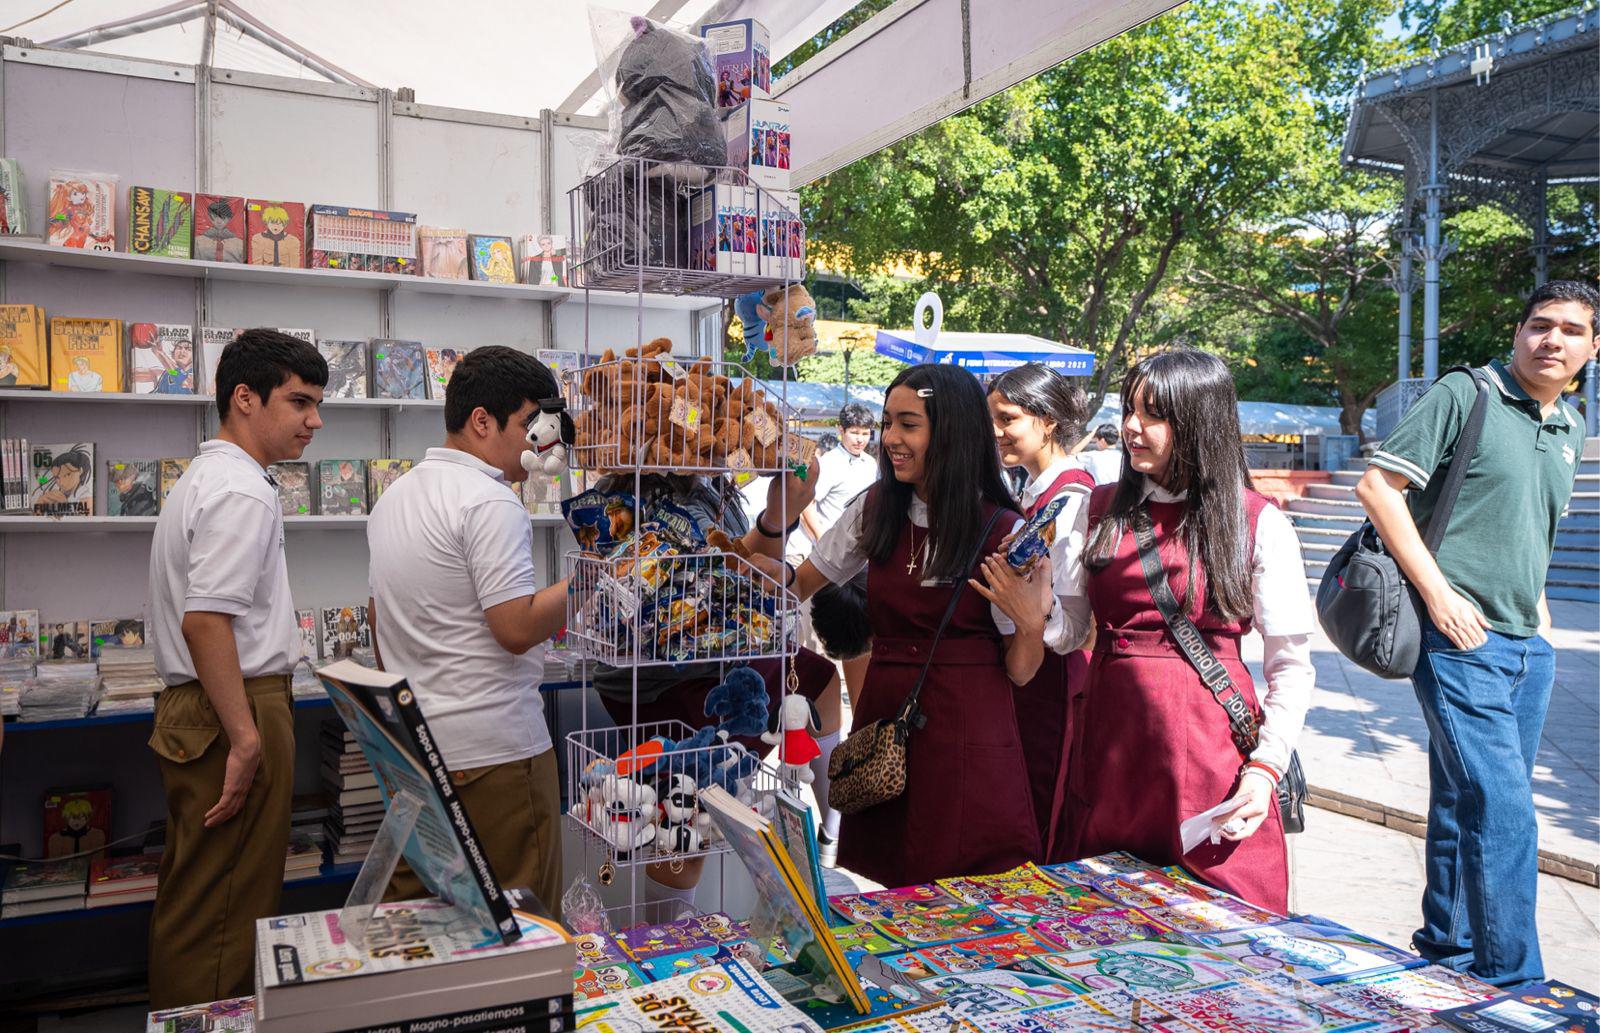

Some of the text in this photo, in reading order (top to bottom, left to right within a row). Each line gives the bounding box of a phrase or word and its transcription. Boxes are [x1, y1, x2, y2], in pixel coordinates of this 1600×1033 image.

[134, 188, 151, 251] CHAINSAW
[54, 320, 112, 336] BANANA
[68, 335, 99, 351] FISH
[33, 452, 52, 468] 05
[34, 502, 90, 513] FULLMETAL
[338, 632, 358, 642] 004
[415, 724, 499, 901] Sopa de letras Magno-pasatiempos
[632, 993, 662, 1013] DE
[409, 1006, 525, 1033] Magno-pasatiempos
